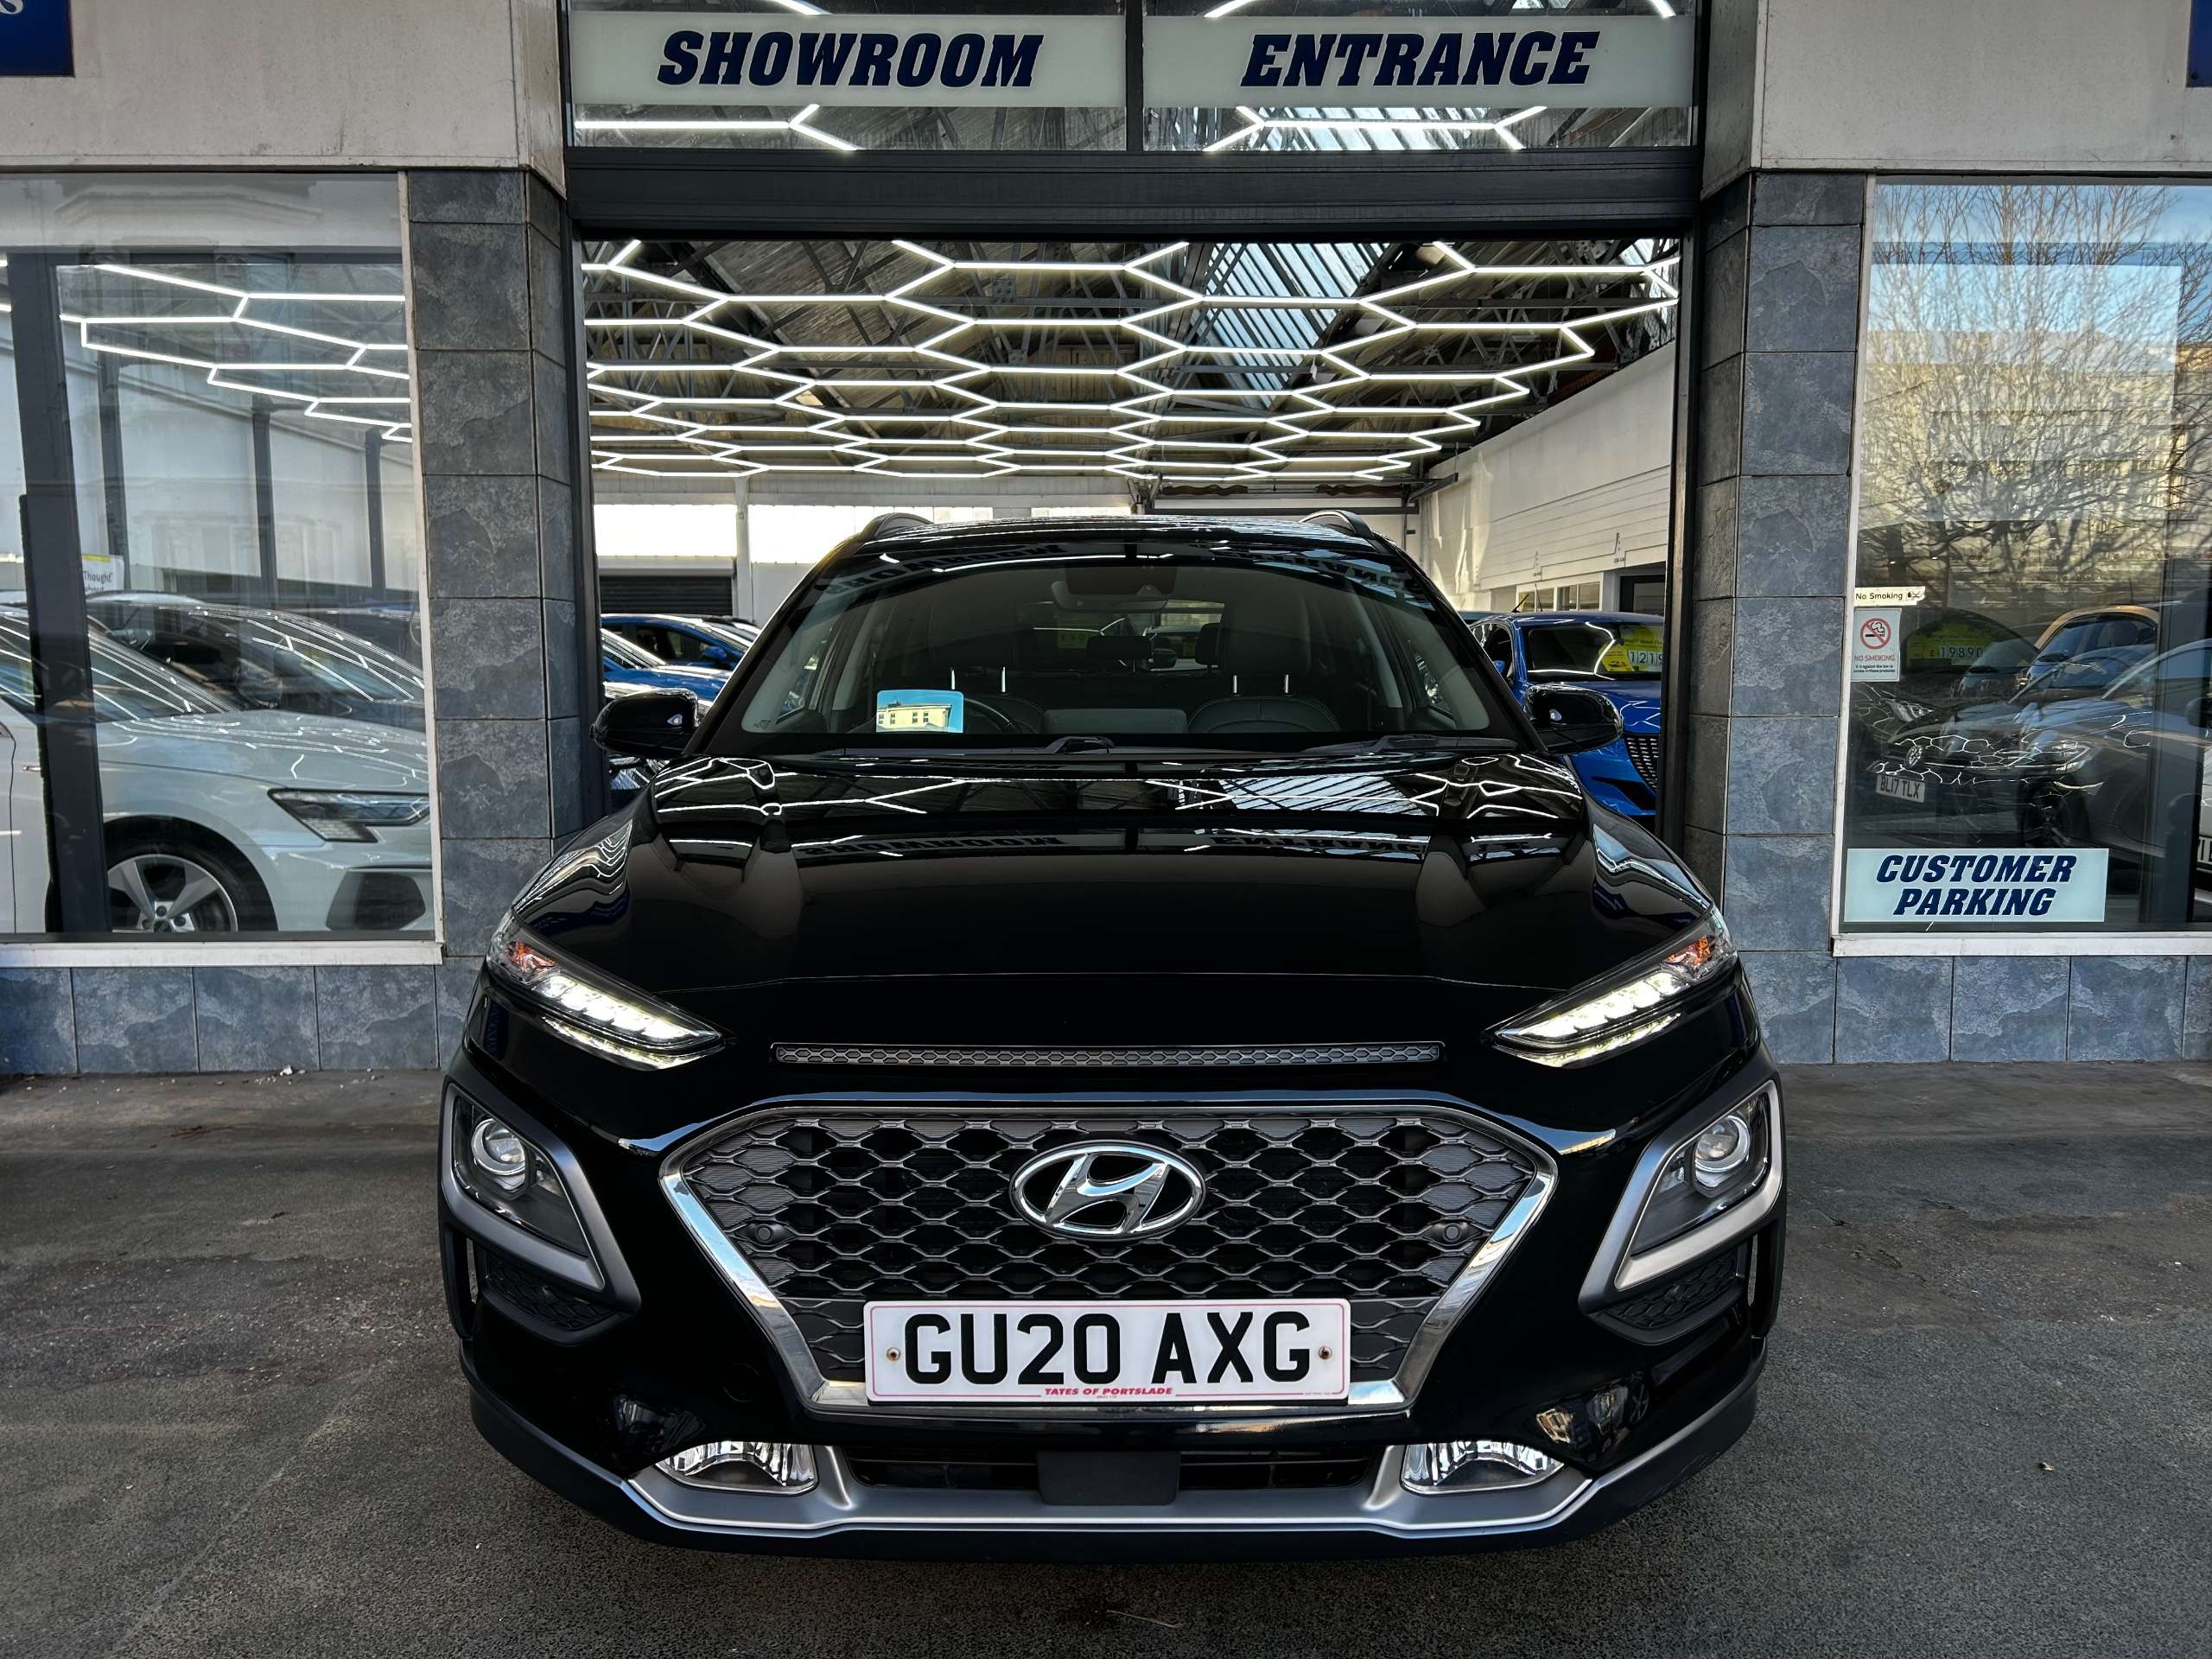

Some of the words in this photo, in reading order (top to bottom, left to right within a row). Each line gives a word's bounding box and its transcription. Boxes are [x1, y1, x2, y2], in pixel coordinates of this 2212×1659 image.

[657, 30, 1044, 87] SHOWROOM
[1240, 30, 1600, 87] ENTRANCE
[1869, 592, 1904, 601] Smoking
[1902, 780, 1920, 798] TLX
[1876, 855, 2077, 882] CUSTOMER
[1892, 887, 2056, 916] PARKING
[905, 1313, 1121, 1384] GU20
[1150, 1311, 1310, 1383] AXG
[1103, 1387, 1173, 1395] PORTSLADE
